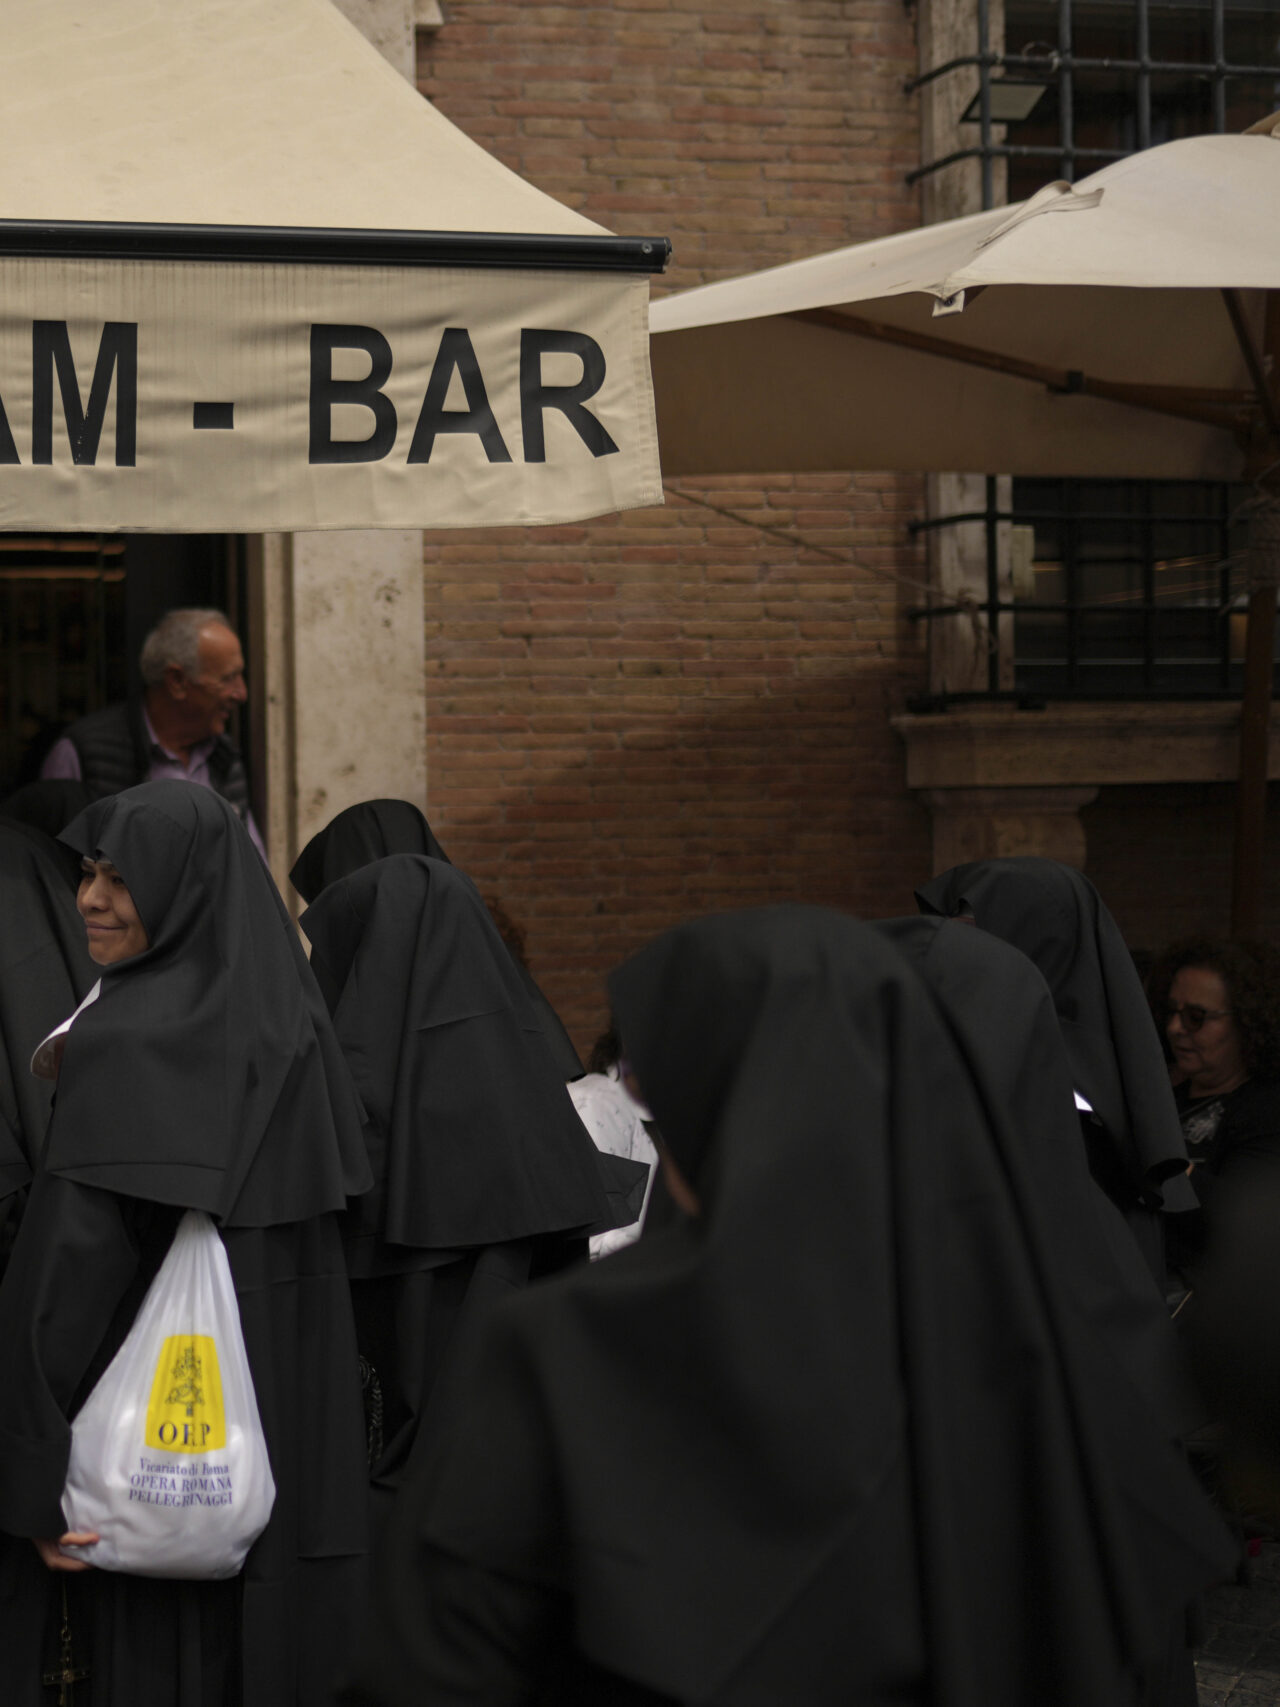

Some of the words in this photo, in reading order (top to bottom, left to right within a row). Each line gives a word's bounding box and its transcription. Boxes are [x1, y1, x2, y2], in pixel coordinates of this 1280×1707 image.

[192, 401, 235, 429] -
[308, 323, 620, 464] BAR
[140, 1457, 187, 1475] Vicariato
[188, 1463, 198, 1476] di
[131, 1474, 176, 1491] OPERA
[182, 1476, 232, 1492] ROMANA
[129, 1489, 232, 1508] PELLEGRINAGGI
